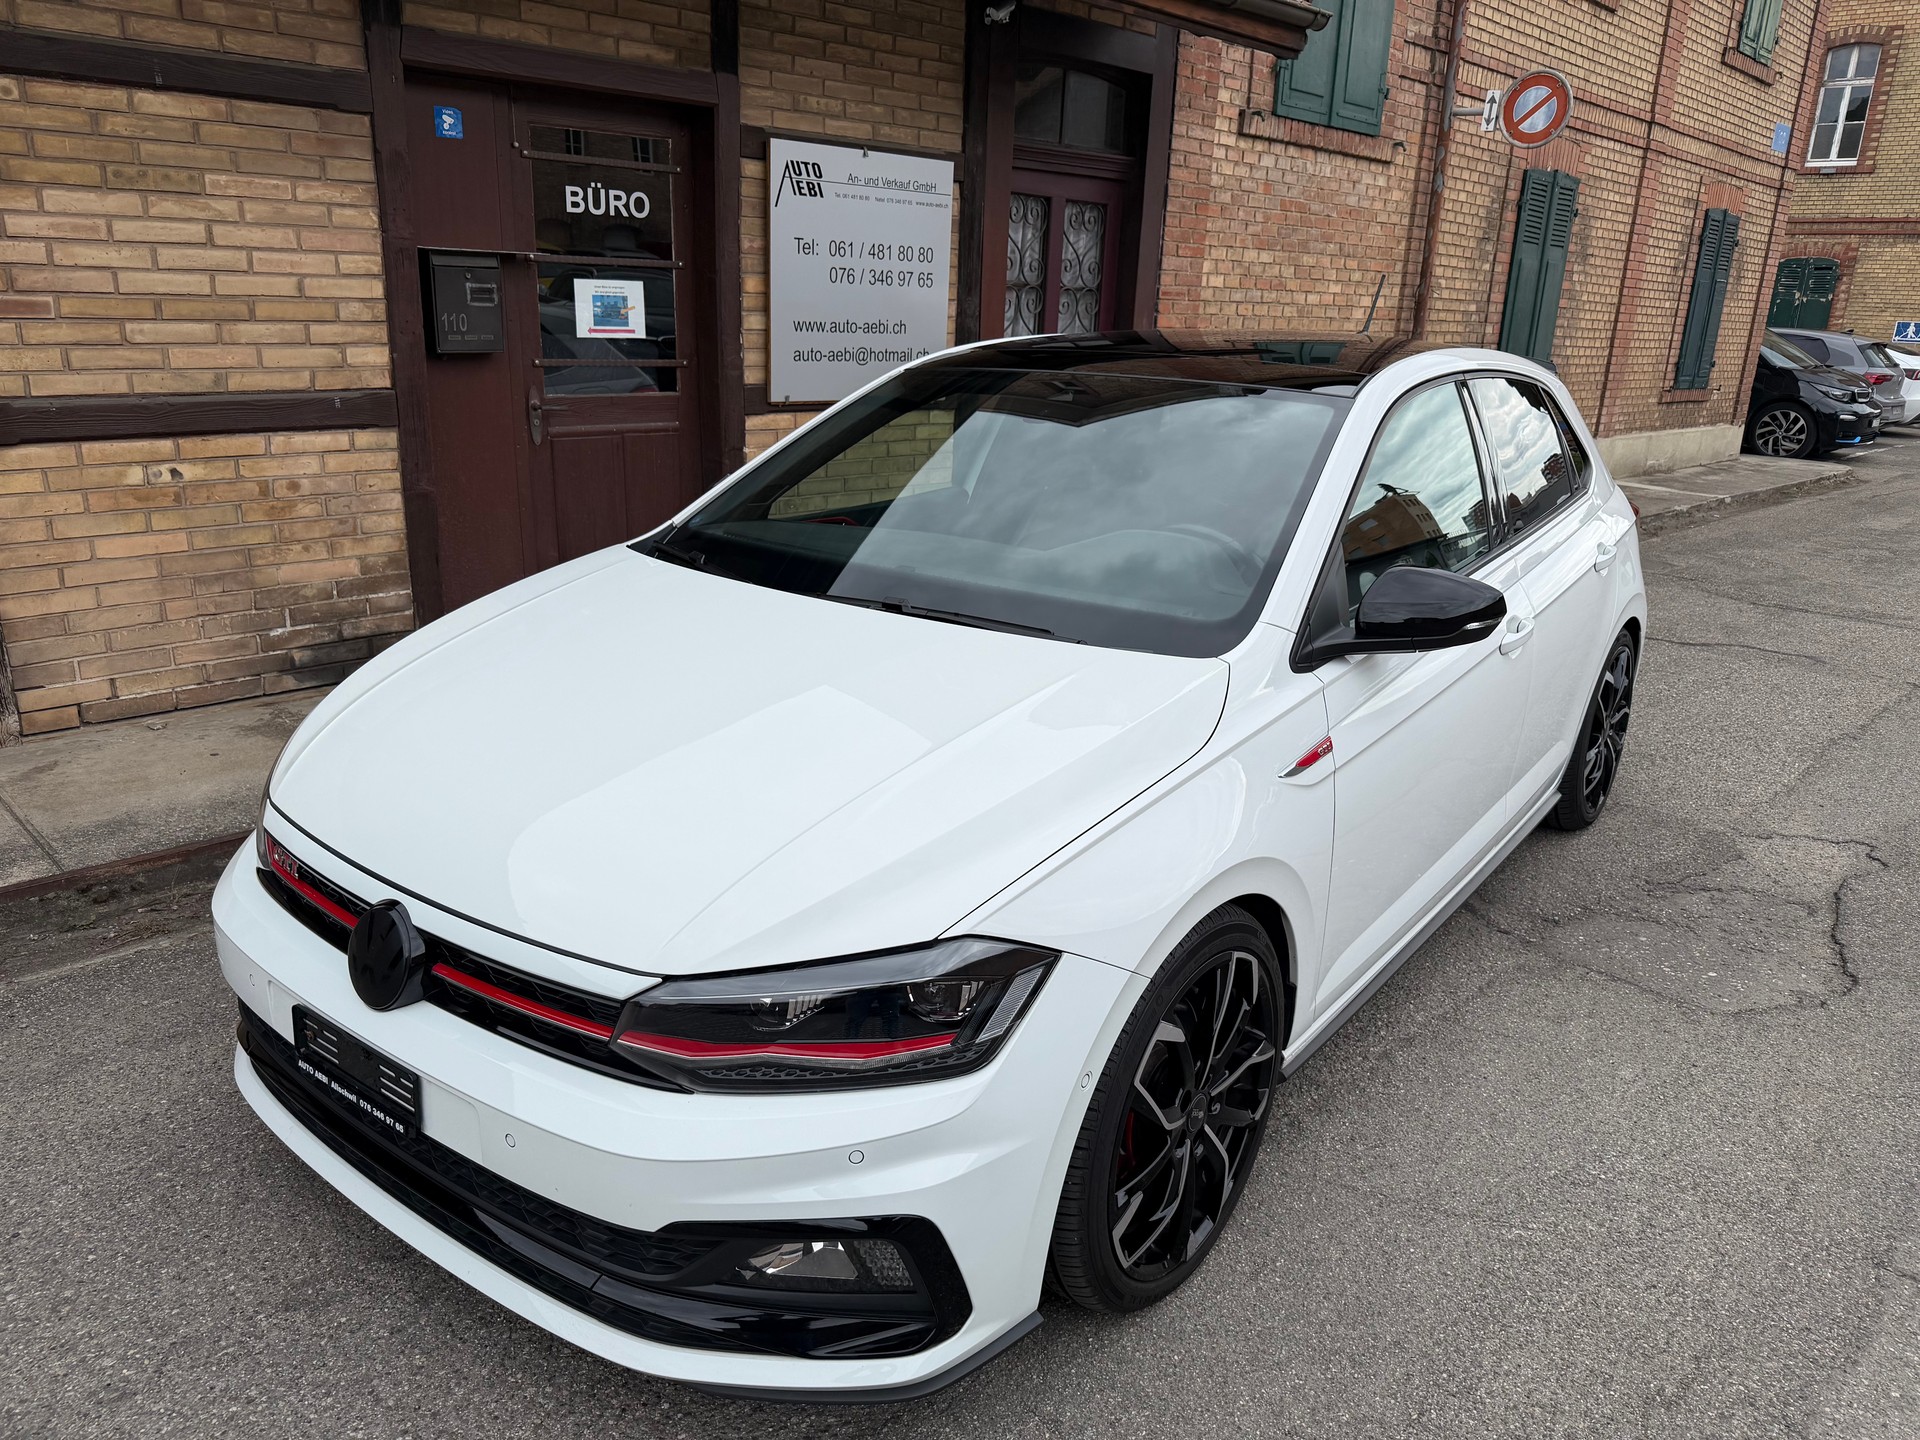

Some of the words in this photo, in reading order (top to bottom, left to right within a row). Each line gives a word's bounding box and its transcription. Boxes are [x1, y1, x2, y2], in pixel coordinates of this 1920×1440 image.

[847, 173, 862, 183] An-
[863, 176, 880, 186] und
[881, 177, 911, 190] Verkauf
[912, 181, 937, 192] GmbH
[565, 182, 650, 219] BÜRO
[794, 237, 819, 256] Tel:
[829, 240, 854, 258] 061
[859, 242, 865, 259] /
[868, 243, 892, 261] 481
[897, 245, 914, 262] 80
[917, 247, 934, 263] 80
[829, 267, 855, 285] 076
[859, 268, 865, 285] /
[868, 269, 894, 286] 346
[897, 271, 914, 287] 97
[917, 272, 934, 288] 65
[441, 313, 468, 332] 110
[793, 319, 907, 335] www.auto-aebi.ch
[298, 1059, 314, 1075] AUTO
[314, 1070, 329, 1085] AEBI
[330, 1080, 357, 1103] Allschwil
[359, 1099, 372, 1113] 076
[372, 1107, 385, 1121] 346
[385, 1115, 394, 1127] 97
[395, 1122, 404, 1133] 65
